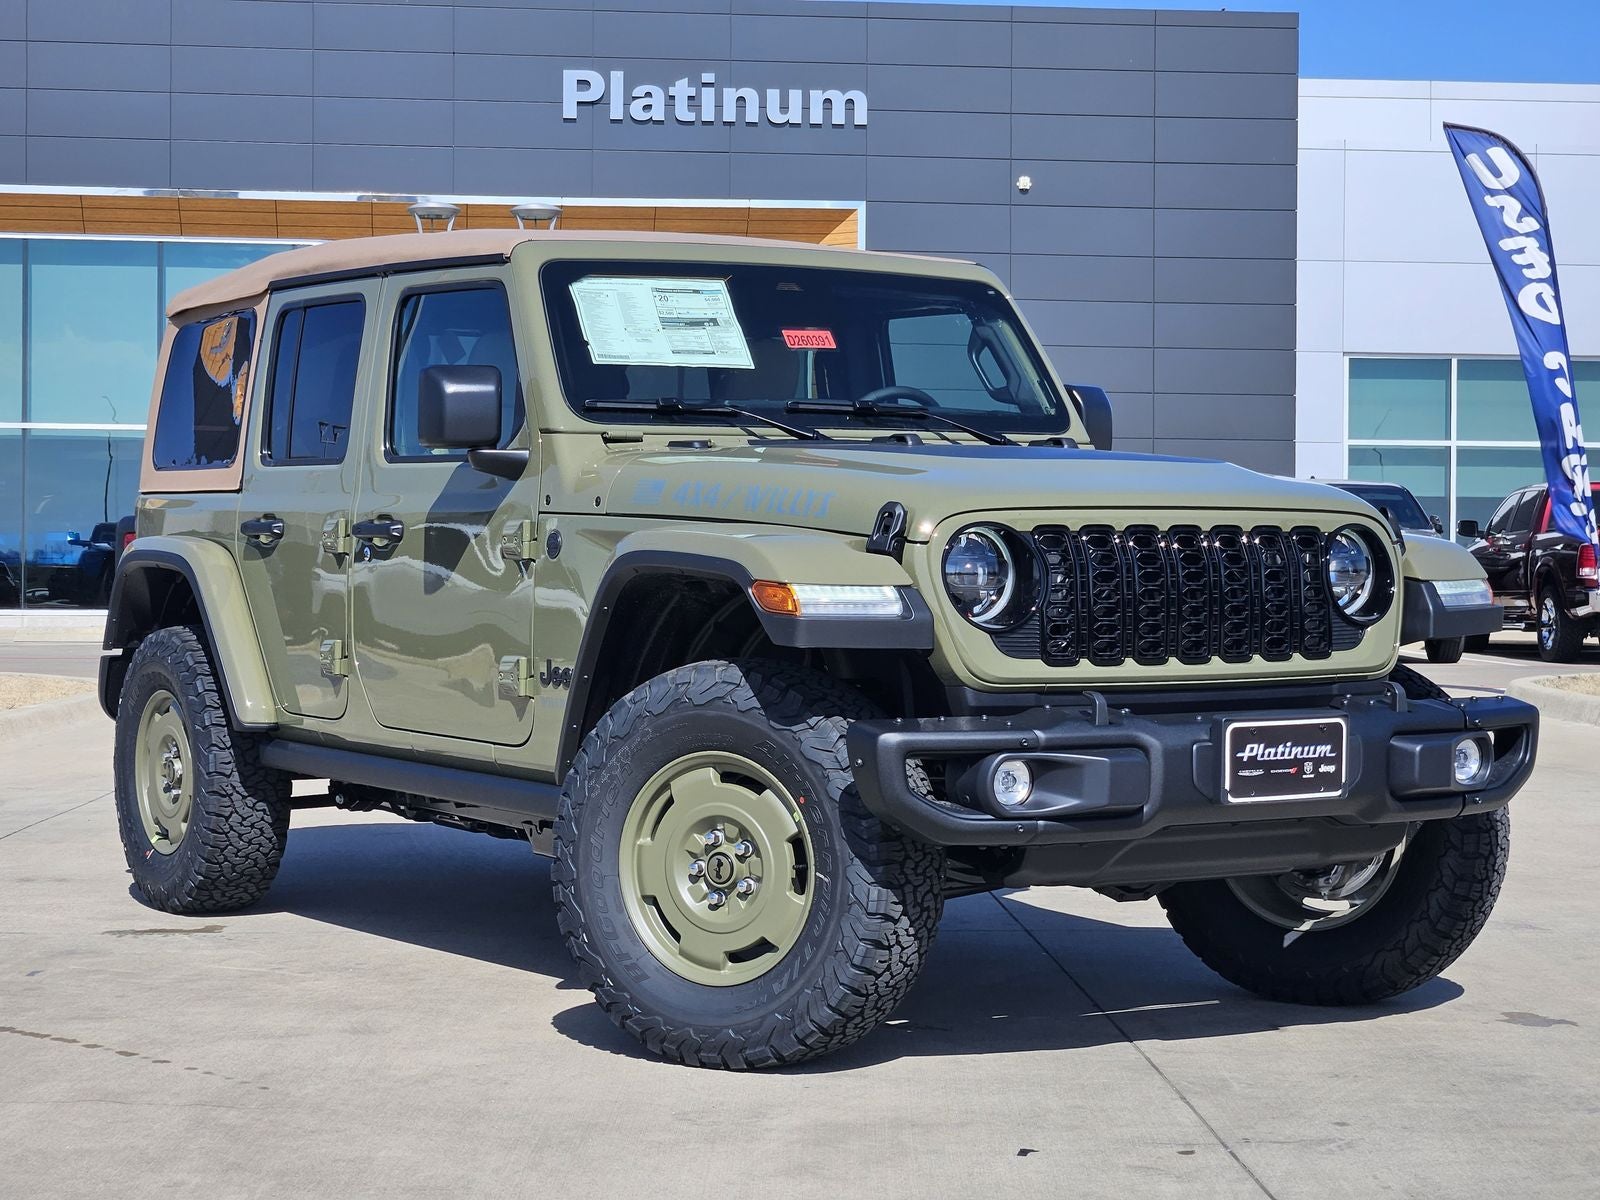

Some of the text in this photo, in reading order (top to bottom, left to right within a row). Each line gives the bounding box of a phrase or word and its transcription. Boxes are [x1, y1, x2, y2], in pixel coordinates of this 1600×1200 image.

[562, 69, 868, 126] Platinum
[786, 335, 832, 346] D260391
[540, 659, 575, 690] Jee
[1236, 742, 1337, 762] Platinum
[1319, 763, 1336, 774] Jeep
[590, 762, 651, 984] BFGoodrich
